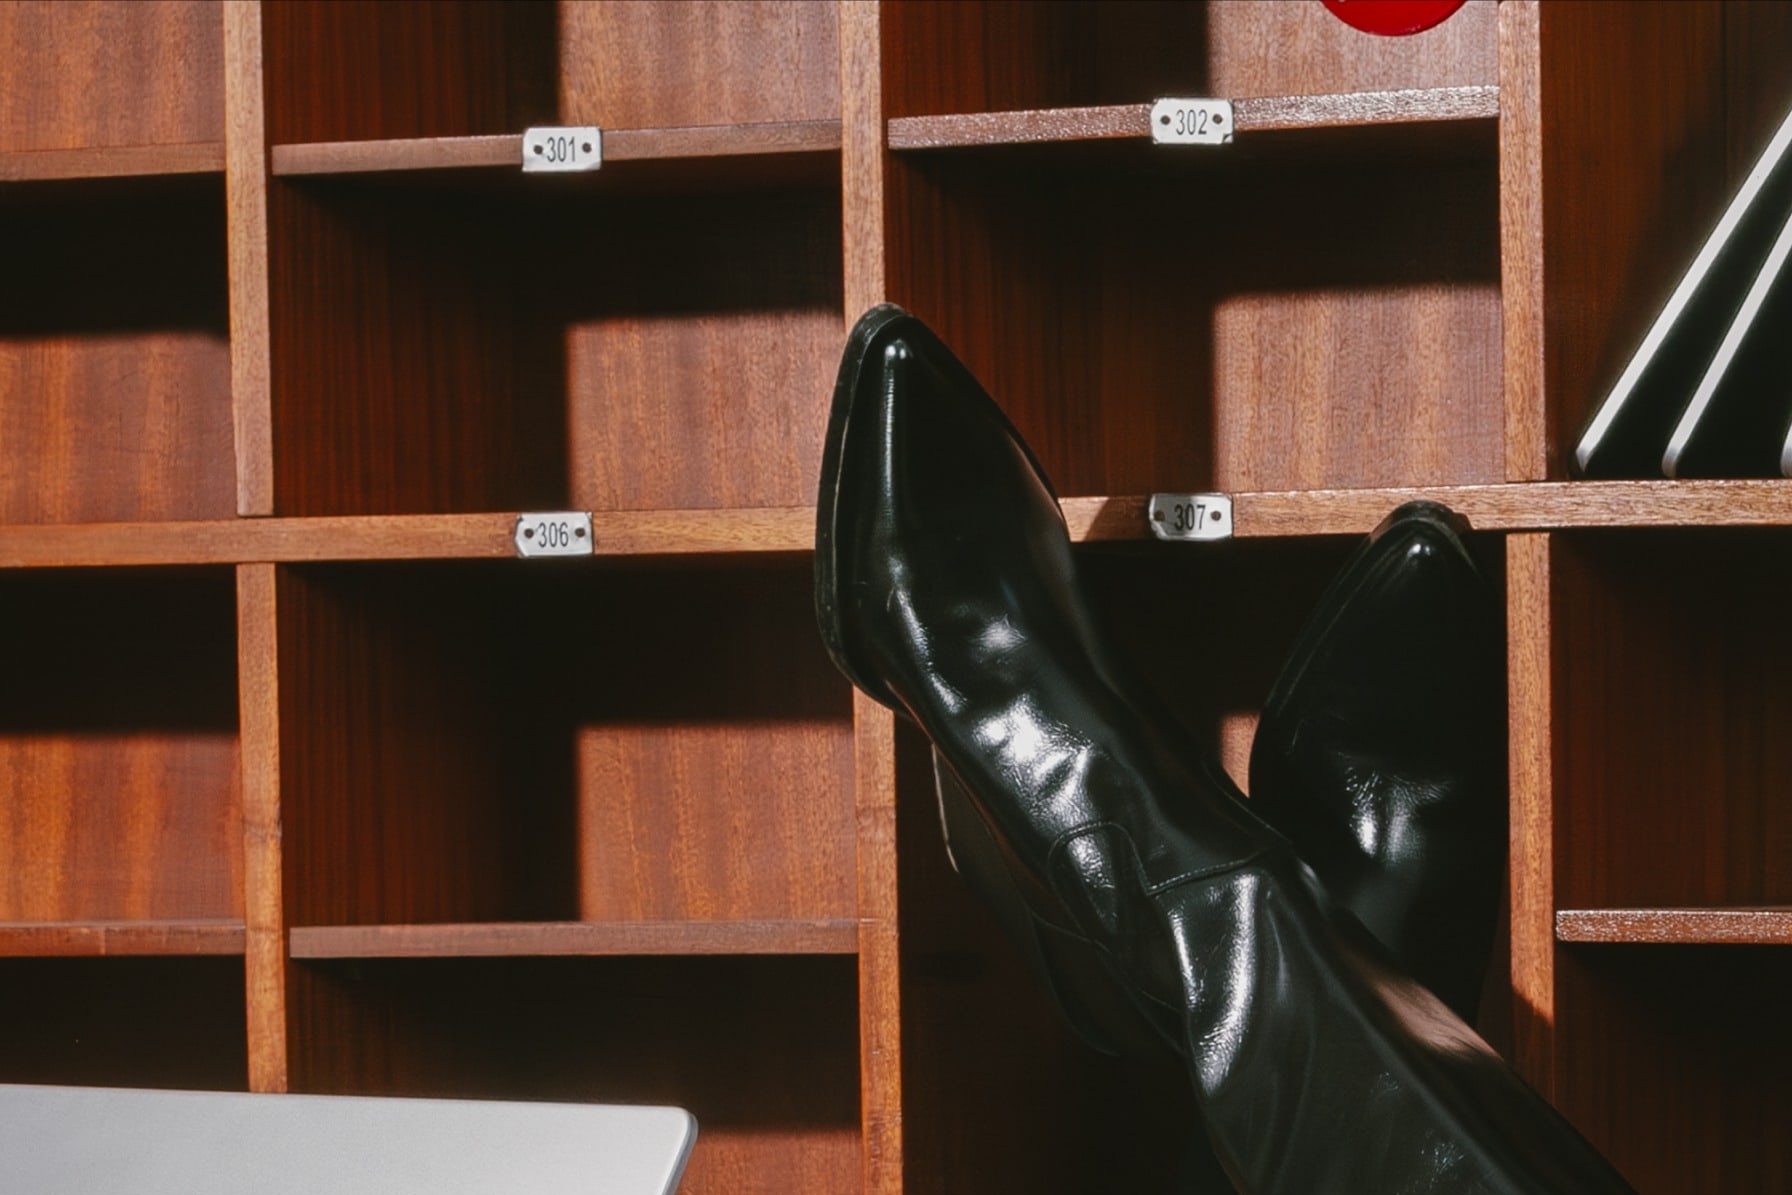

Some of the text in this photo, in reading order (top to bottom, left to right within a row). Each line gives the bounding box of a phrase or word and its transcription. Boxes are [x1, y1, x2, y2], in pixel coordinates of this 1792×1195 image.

[1176, 109, 1208, 135] 302
[546, 136, 576, 163] 301
[1174, 503, 1206, 531] 307
[537, 522, 569, 548] 306
